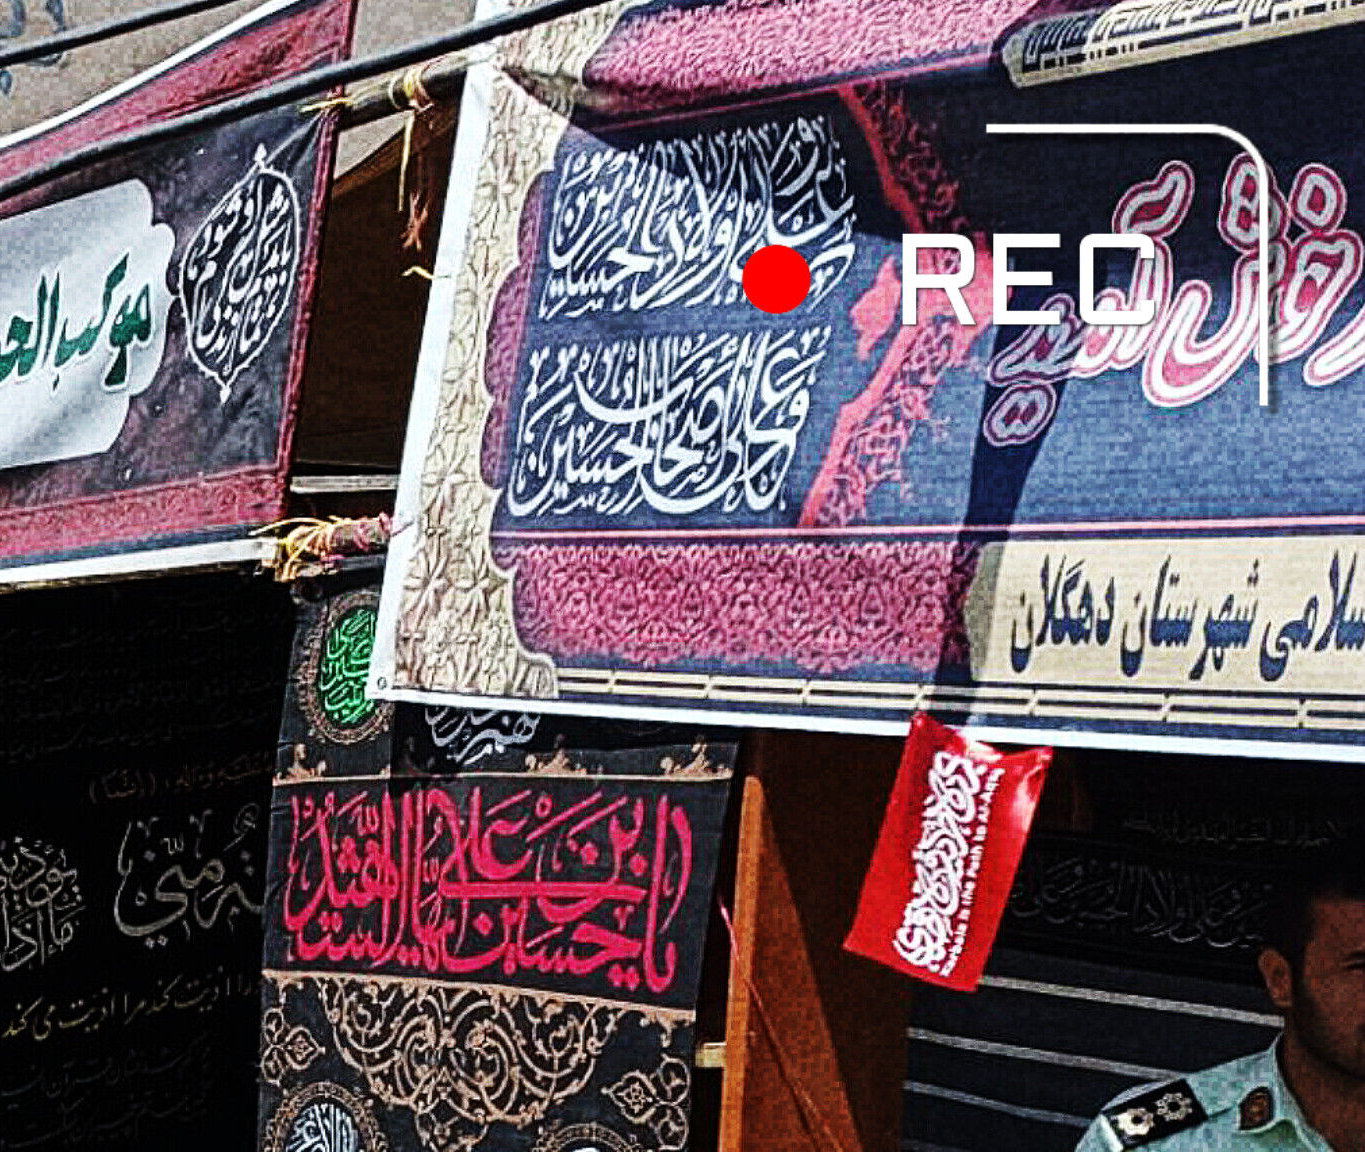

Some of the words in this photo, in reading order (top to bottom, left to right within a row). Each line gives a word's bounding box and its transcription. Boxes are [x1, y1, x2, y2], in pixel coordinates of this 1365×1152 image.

[54, 252, 151, 396] موکب
[1009, 554, 1116, 675] دهگلان
[1119, 553, 1262, 682] شهرستان
[1258, 550, 1365, 683] سلامی
